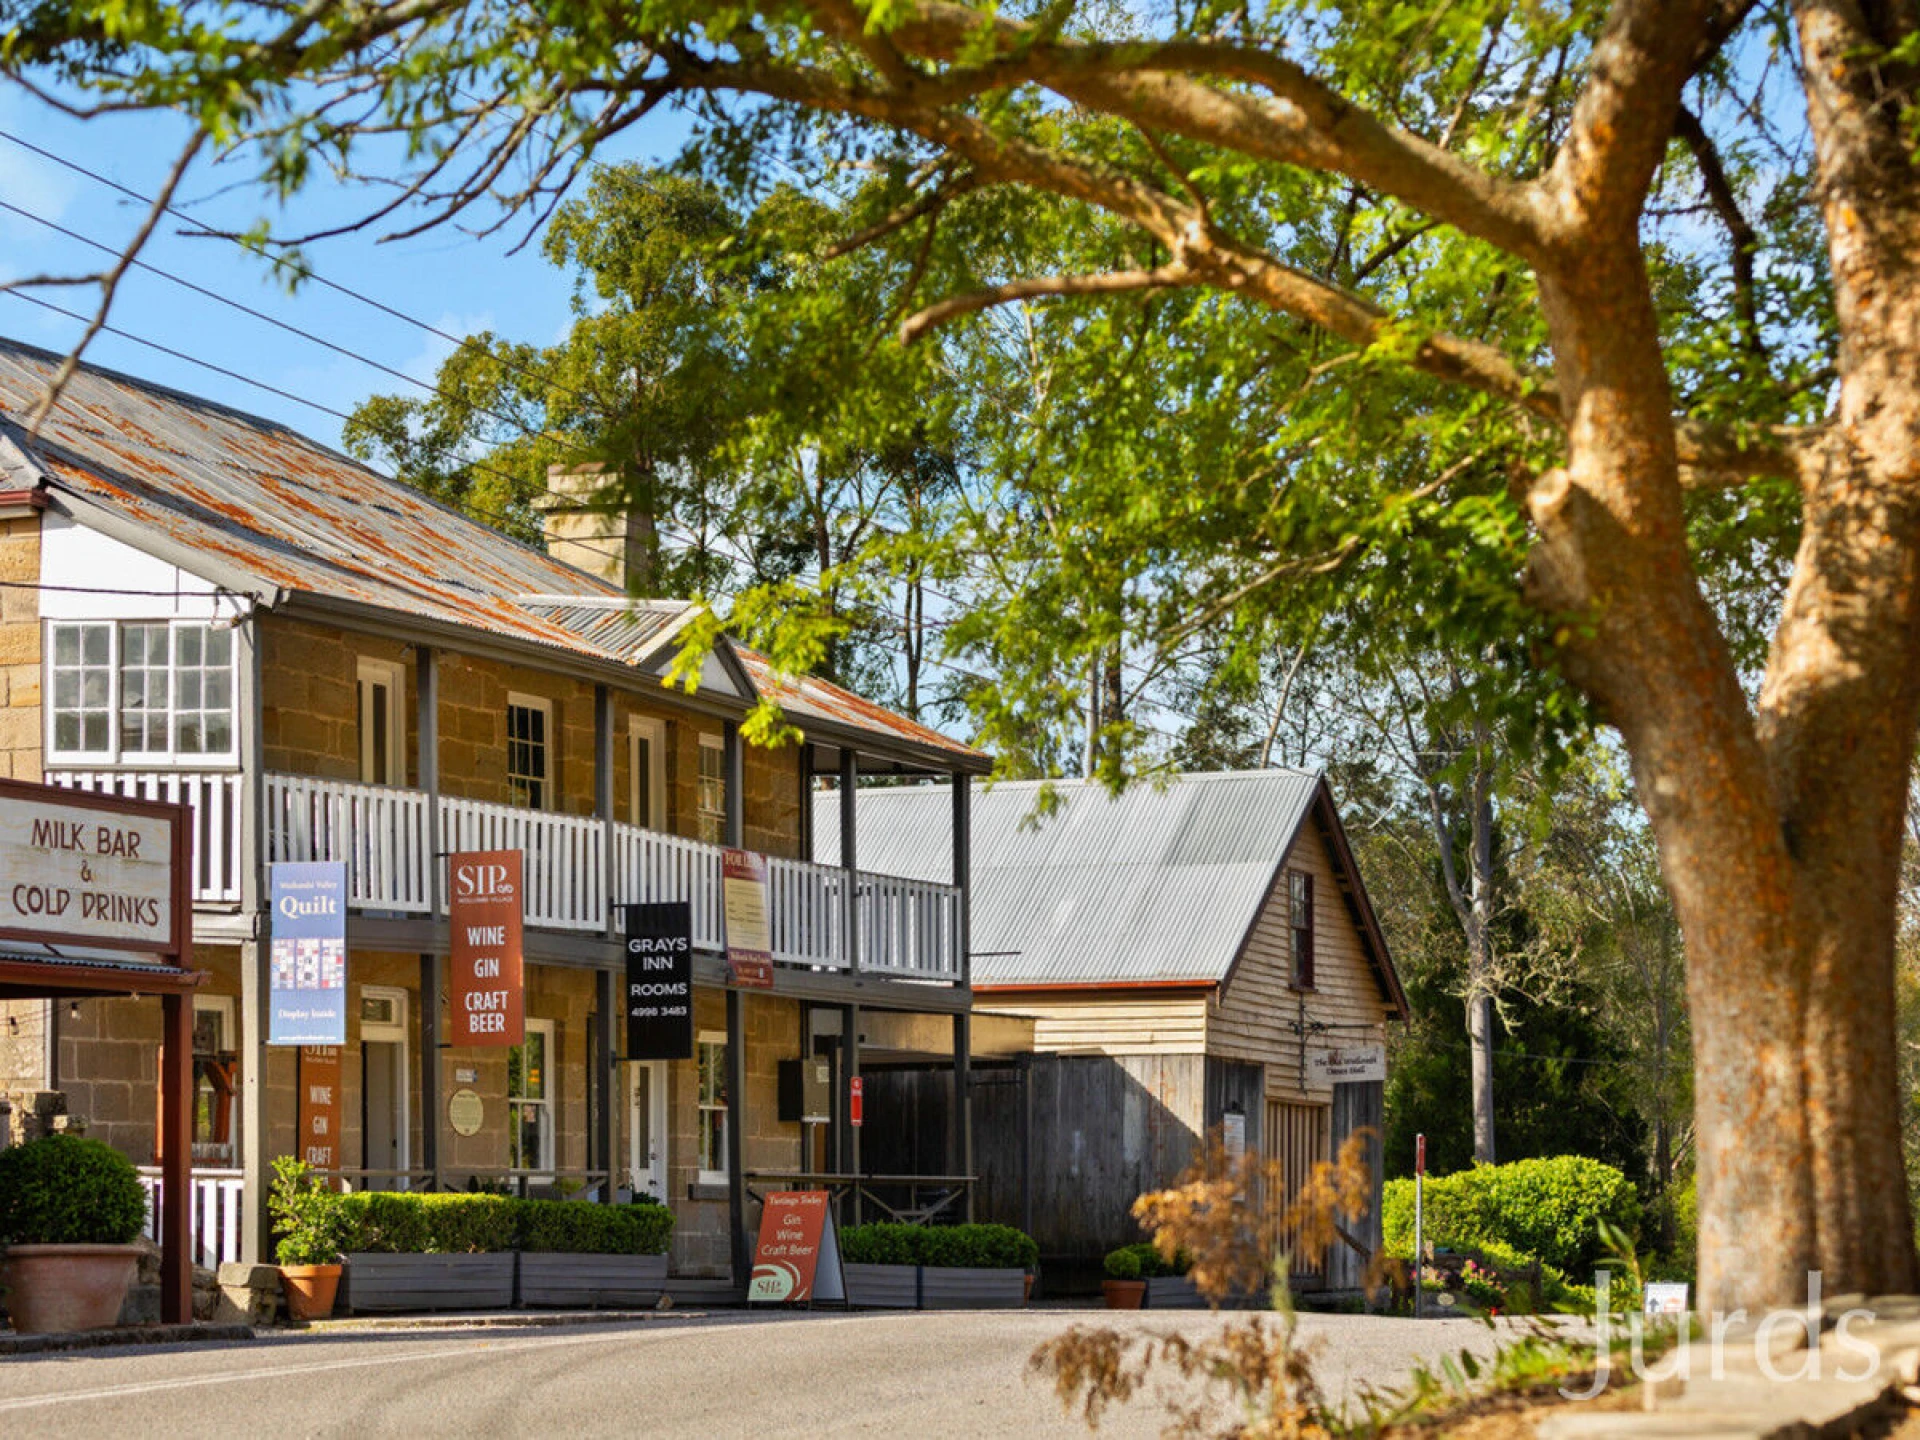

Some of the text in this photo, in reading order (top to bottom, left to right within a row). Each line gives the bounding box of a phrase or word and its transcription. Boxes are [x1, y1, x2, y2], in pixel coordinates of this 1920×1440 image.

[31, 818, 141, 858] MILK BAR
[81, 859, 92, 882] &
[457, 865, 507, 896] SIP
[12, 884, 159, 926] COLD DRINKS
[279, 895, 337, 919] Quilt
[467, 926, 505, 946] WINE
[628, 937, 687, 953] GRAYS
[473, 958, 500, 978] GIN
[642, 956, 673, 971] INN
[631, 983, 687, 996] ROOMS
[464, 991, 508, 1011] CRAFT
[469, 1013, 505, 1033] BEER
[306, 1146, 332, 1165] CRAFT
[783, 1214, 802, 1225] Gin
[776, 1228, 804, 1241] Wine
[761, 1245, 814, 1256] Craft Beer
